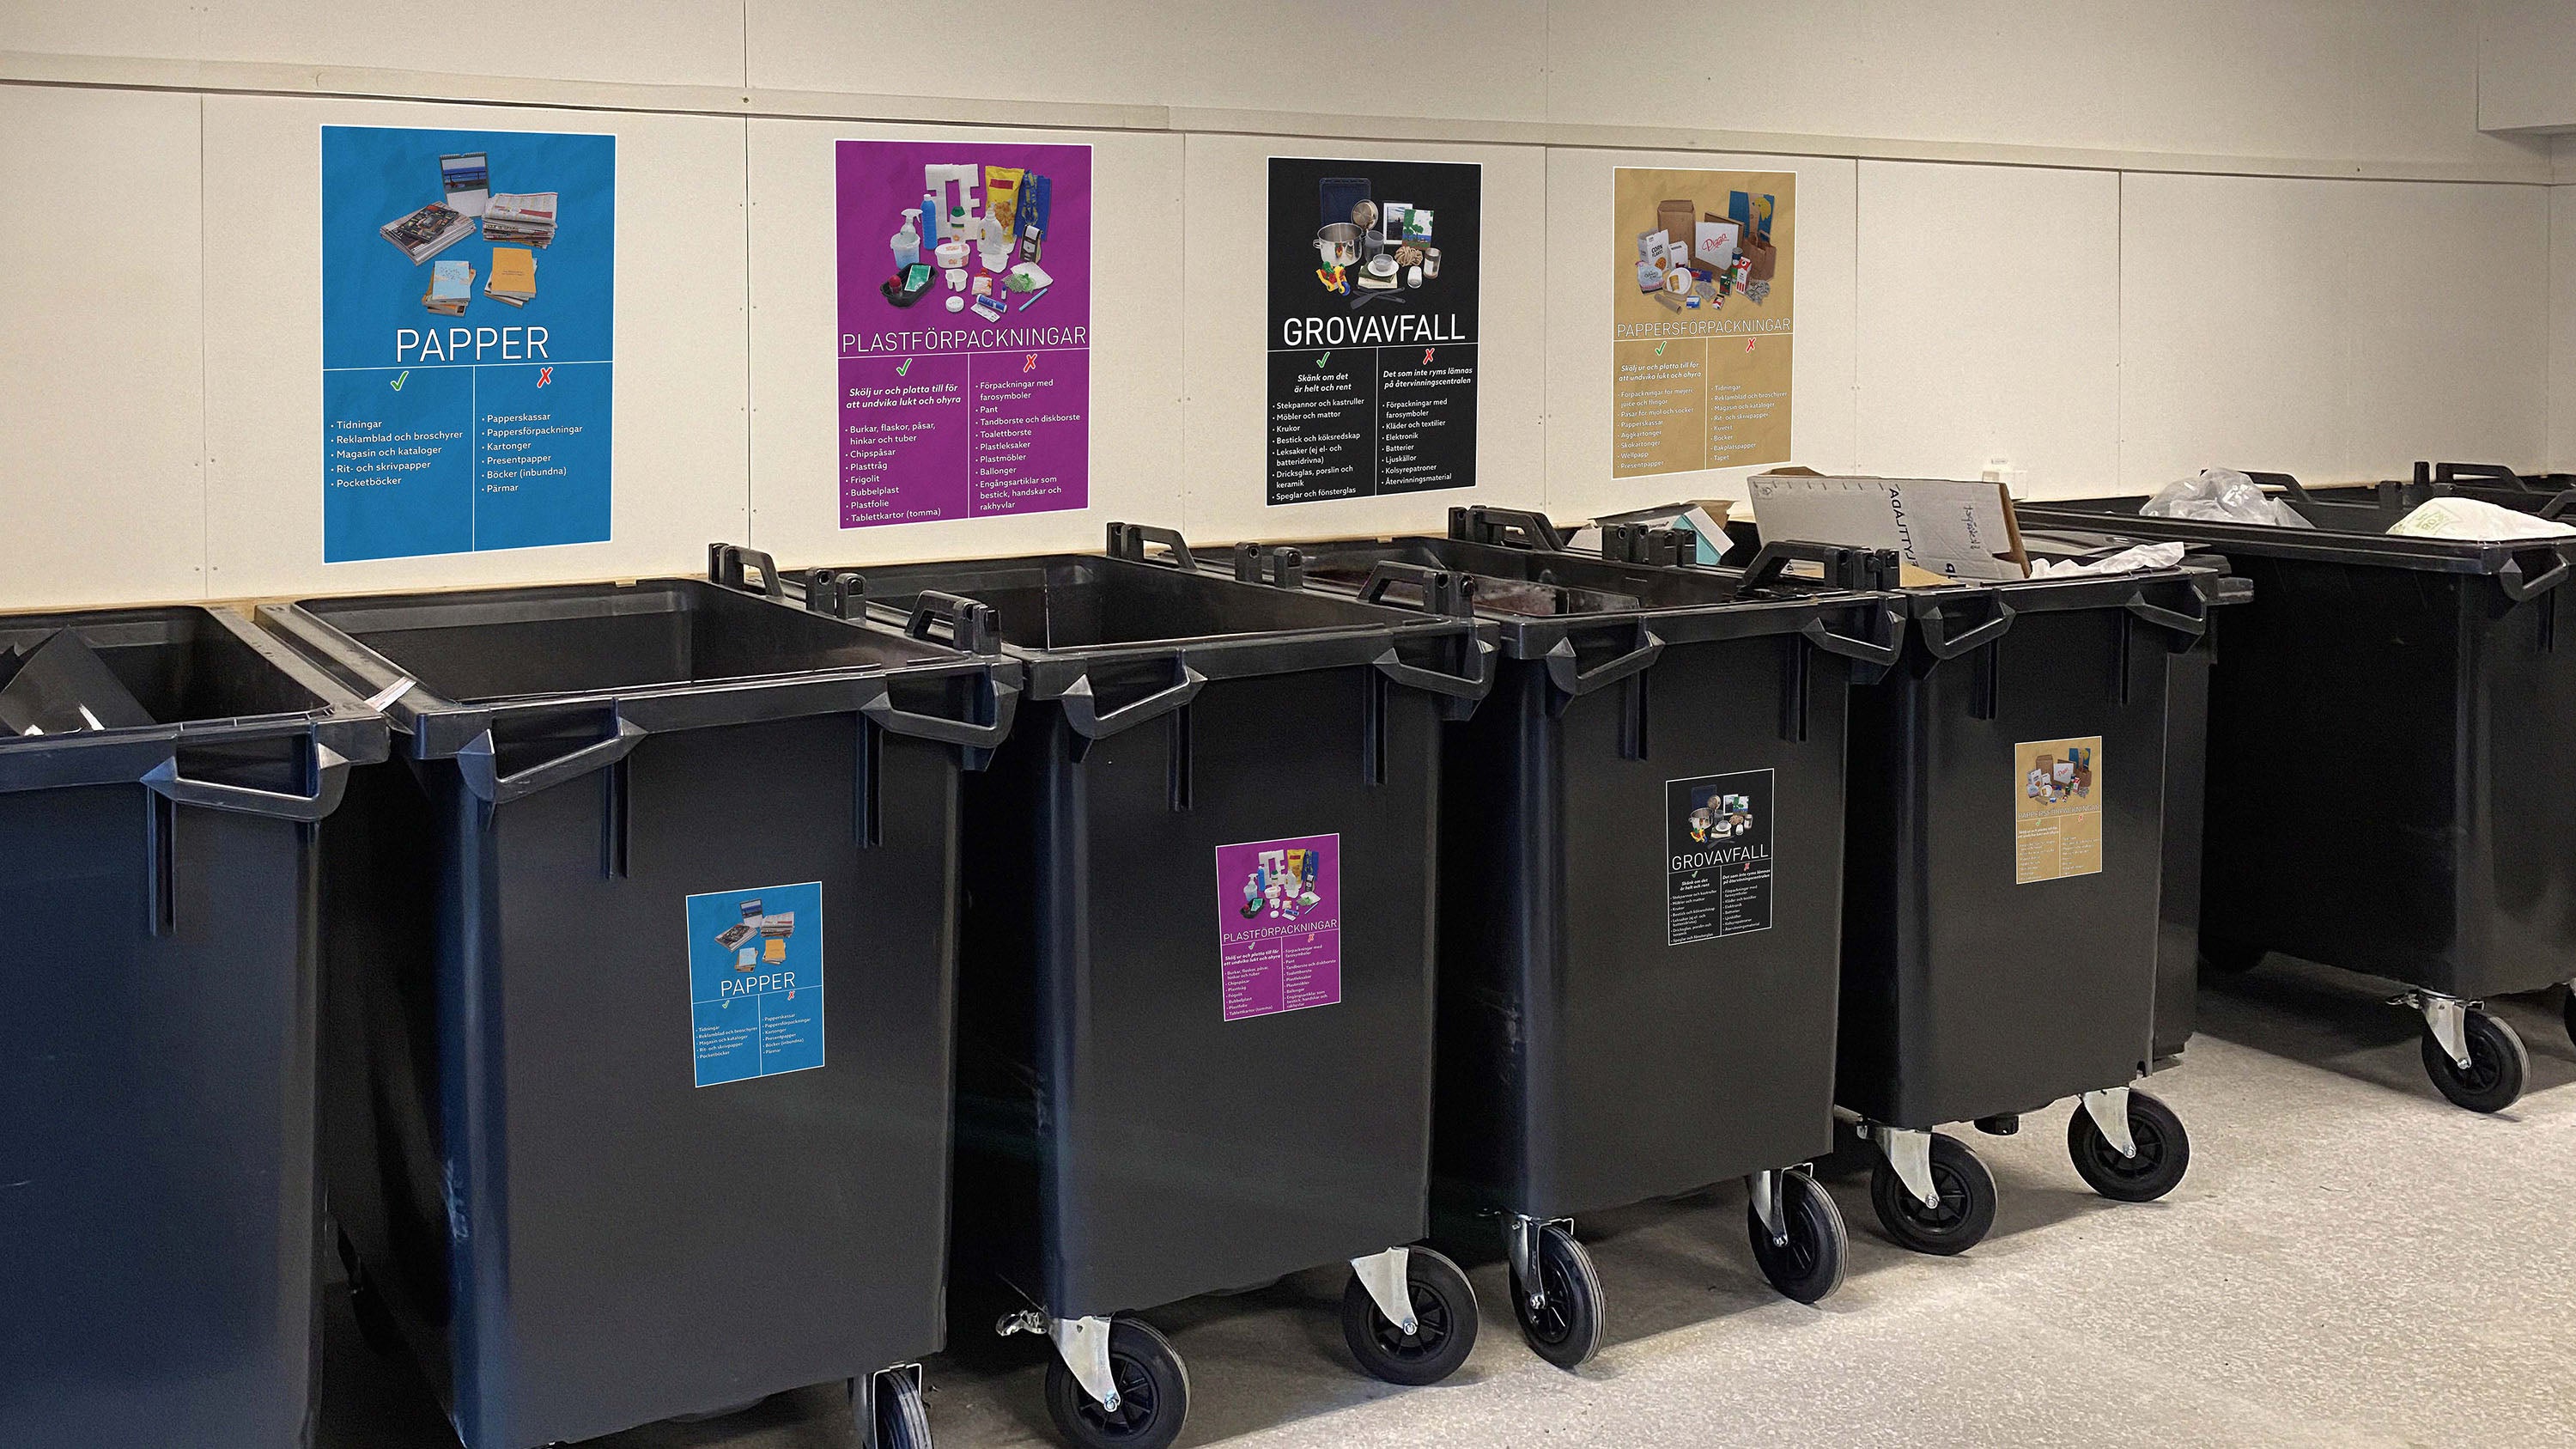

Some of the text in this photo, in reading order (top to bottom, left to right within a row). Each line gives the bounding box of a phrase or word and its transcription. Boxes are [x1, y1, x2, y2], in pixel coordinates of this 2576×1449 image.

[1284, 314, 1466, 346] GROVAVFALL
[1617, 318, 1790, 338] PAPPERSFÖRPACKNINGAR
[396, 326, 550, 362] PAPPER
[842, 326, 1086, 353] PLASTFÖRPACKNINGAR
[1658, 362, 1679, 371] platta
[1297, 373, 1321, 382] Skänk
[1335, 372, 1349, 381] det
[1382, 369, 1396, 378] Det
[1428, 368, 1447, 377] ryms
[1629, 373, 1656, 381] undvika
[1682, 370, 1702, 379] ohyra
[980, 378, 1054, 391] Förpackningar med
[1293, 385, 1303, 393] är
[1303, 383, 1319, 393] helt
[1320, 382, 1334, 392] och
[1383, 376, 1471, 390] på återvinningscentralen
[848, 387, 872, 397] Skölj
[884, 386, 901, 395] och
[902, 385, 930, 395] platta
[931, 383, 944, 393] till
[945, 383, 958, 392] för
[845, 395, 961, 409] att undvika lukt och ohyra
[980, 391, 1031, 402] farosymboler
[1714, 393, 1747, 401] Reklamblad
[1276, 397, 1364, 410] Stekpannor och kastruller
[1386, 399, 1432, 410] Förpackningar
[487, 412, 551, 424] Papperskassar
[980, 413, 1080, 426] Tandborste och diskborste
[1276, 412, 1302, 421] Möbler
[1385, 409, 1429, 419] farosymboler
[336, 419, 382, 430] Tidningar
[849, 421, 935, 434] Burkar, flaskor, påsar,
[1276, 424, 1301, 433] Krukor
[1407, 420, 1420, 429] och
[1420, 419, 1446, 428] textilier
[1620, 420, 1663, 429] Papperskassar
[487, 424, 583, 438] Pappersförpackningar
[980, 429, 1032, 438] Toalettborste
[1385, 431, 1419, 441] Elektronik
[336, 430, 463, 444] Reklamblad och broschyrer
[849, 434, 917, 445] hinkar och tuber
[1276, 431, 1361, 444] Bestick och köksredskap
[487, 441, 532, 452] Kartonger
[980, 441, 1031, 451] Plastleksaker
[1276, 447, 1308, 456] Leksaker
[1309, 446, 1318, 455] (ej
[1328, 443, 1342, 452] och
[1385, 443, 1414, 453] Batterier
[1620, 440, 1661, 449] Skokartonger
[336, 446, 442, 460] Magasin och kataloger
[849, 447, 896, 459] Chipspåsar
[980, 453, 1026, 463] Plastmöbler
[487, 455, 551, 465] Presentpapper
[1276, 455, 1324, 466] batteridrivna)
[1385, 454, 1417, 465] Ljuskällor
[1620, 460, 1664, 469] Presentpapper
[336, 461, 431, 473] Rit- och skrivpapper
[850, 460, 888, 471] Plasttråg
[980, 466, 1017, 476] Ballonger
[1276, 464, 1353, 478] Dricksglas, porslin och
[1385, 464, 1437, 474] Kolsyrepatroner
[486, 466, 567, 479] Böcker (inbundna)
[336, 476, 402, 488] Pocketböcker
[850, 474, 880, 484] Frigolit
[980, 476, 1039, 489] Engångsartiklar
[1276, 478, 1304, 489] keramik
[1384, 472, 1452, 485] Återvinningsmaterial
[486, 484, 519, 493] Pärmar
[850, 486, 899, 496] Bubbelplast
[980, 485, 1061, 499] bestick, handskar och
[1275, 486, 1357, 501] Speglar och fönsterglas
[850, 499, 890, 509] Plastfolie
[980, 500, 1016, 510] rakhyvlar
[850, 507, 941, 521] Tablettkartor (tomma)
[1672, 844, 1769, 871] GROVAVFALL
[1223, 919, 1337, 943] PLASTFÖRPACKNINGAR
[720, 971, 795, 997] PAPPER
